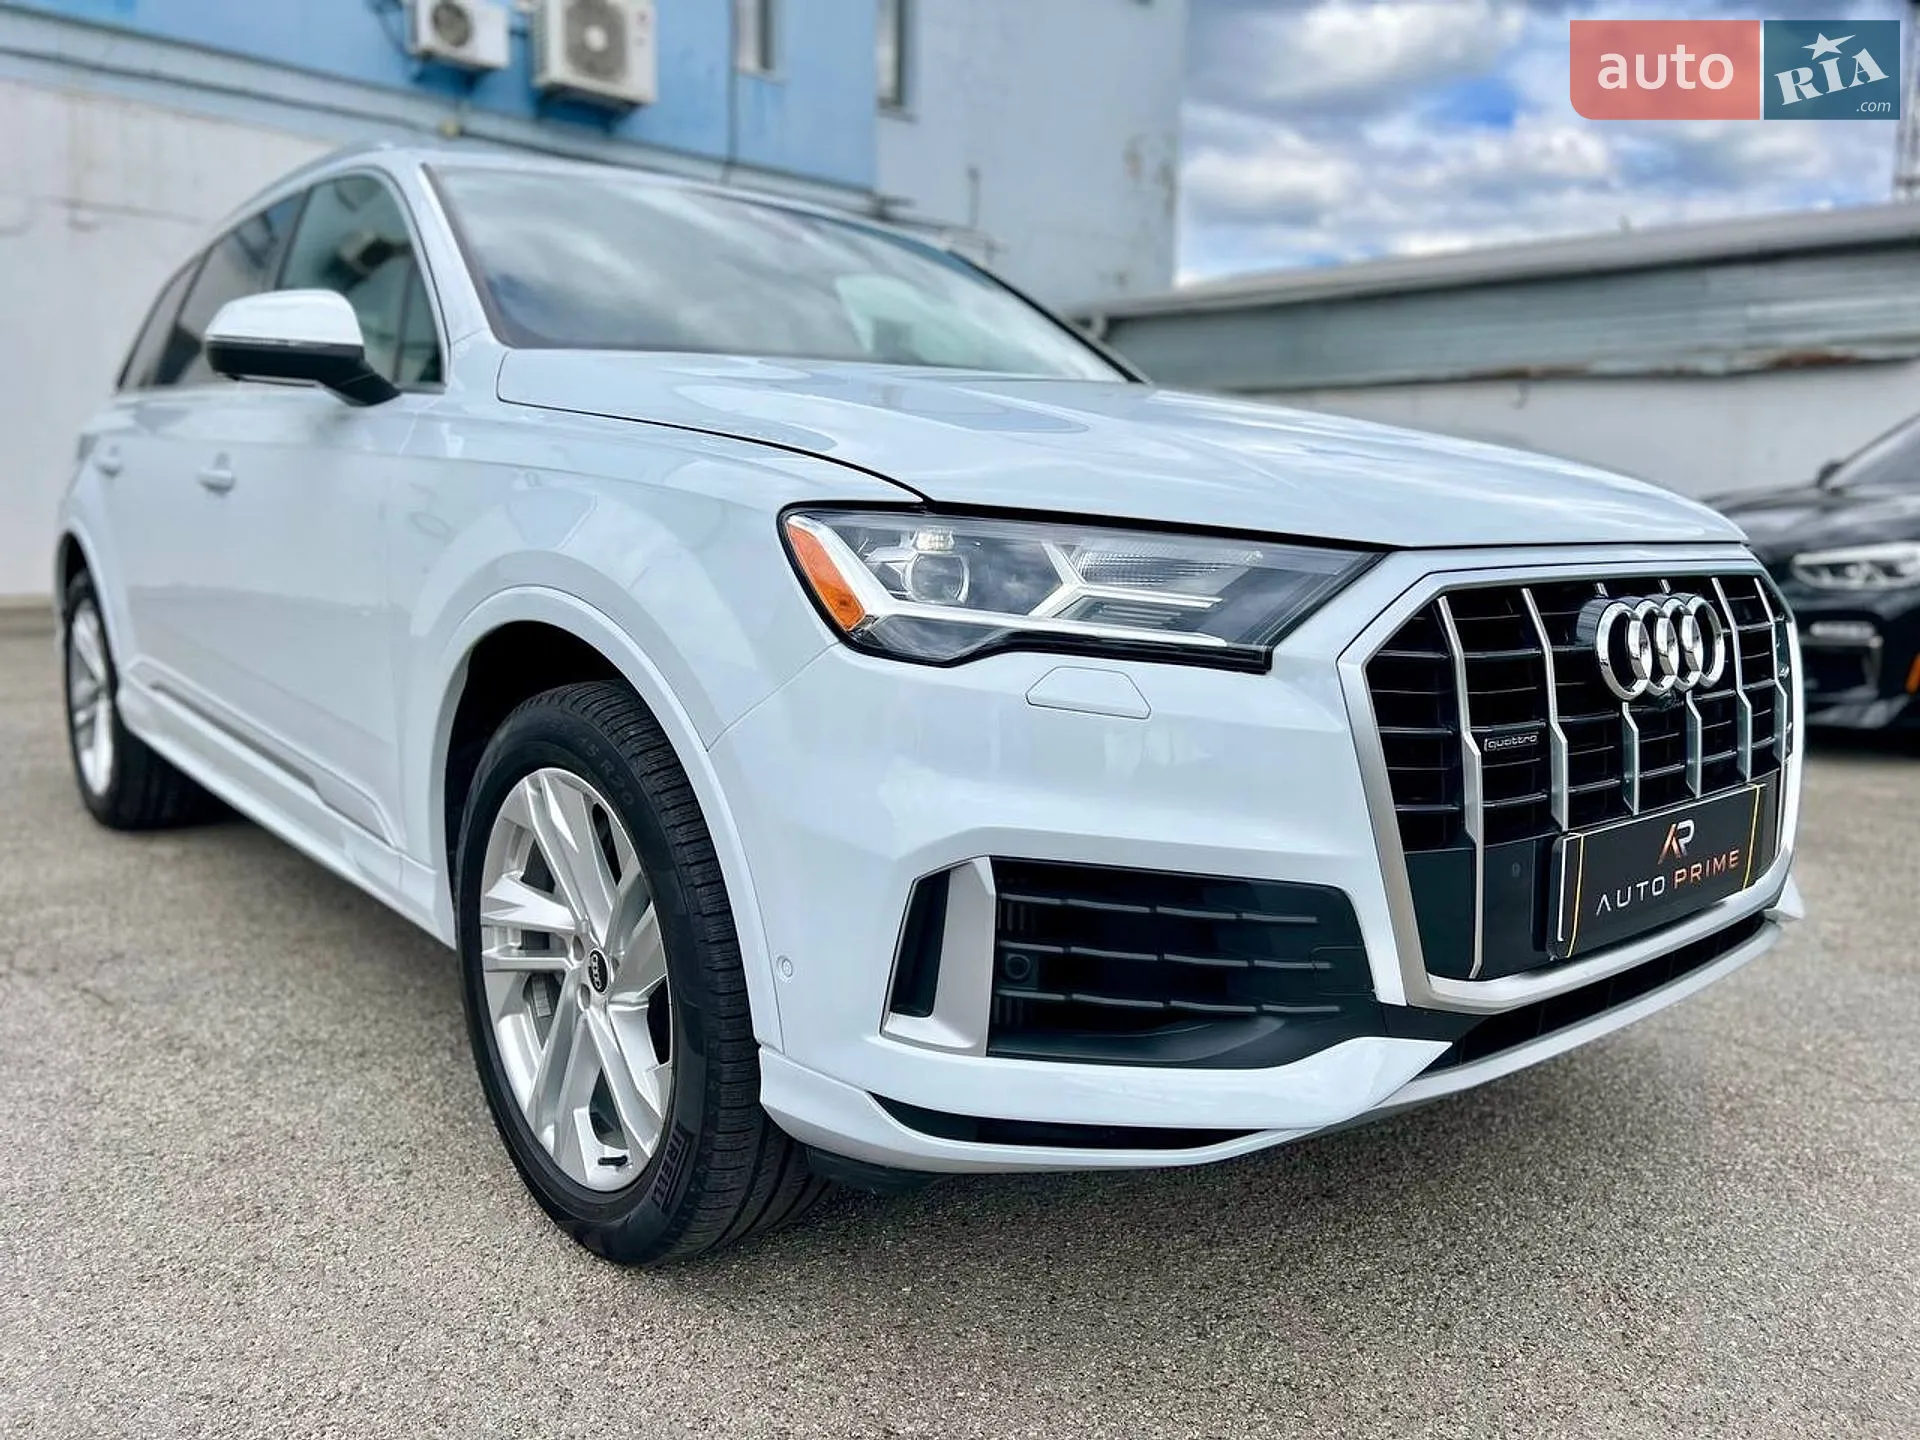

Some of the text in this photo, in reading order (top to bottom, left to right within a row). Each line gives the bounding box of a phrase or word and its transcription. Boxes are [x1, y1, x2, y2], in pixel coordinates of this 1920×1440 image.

[1488, 735, 1537, 750] quattro
[1595, 849, 1740, 917] AUTO PRIME
